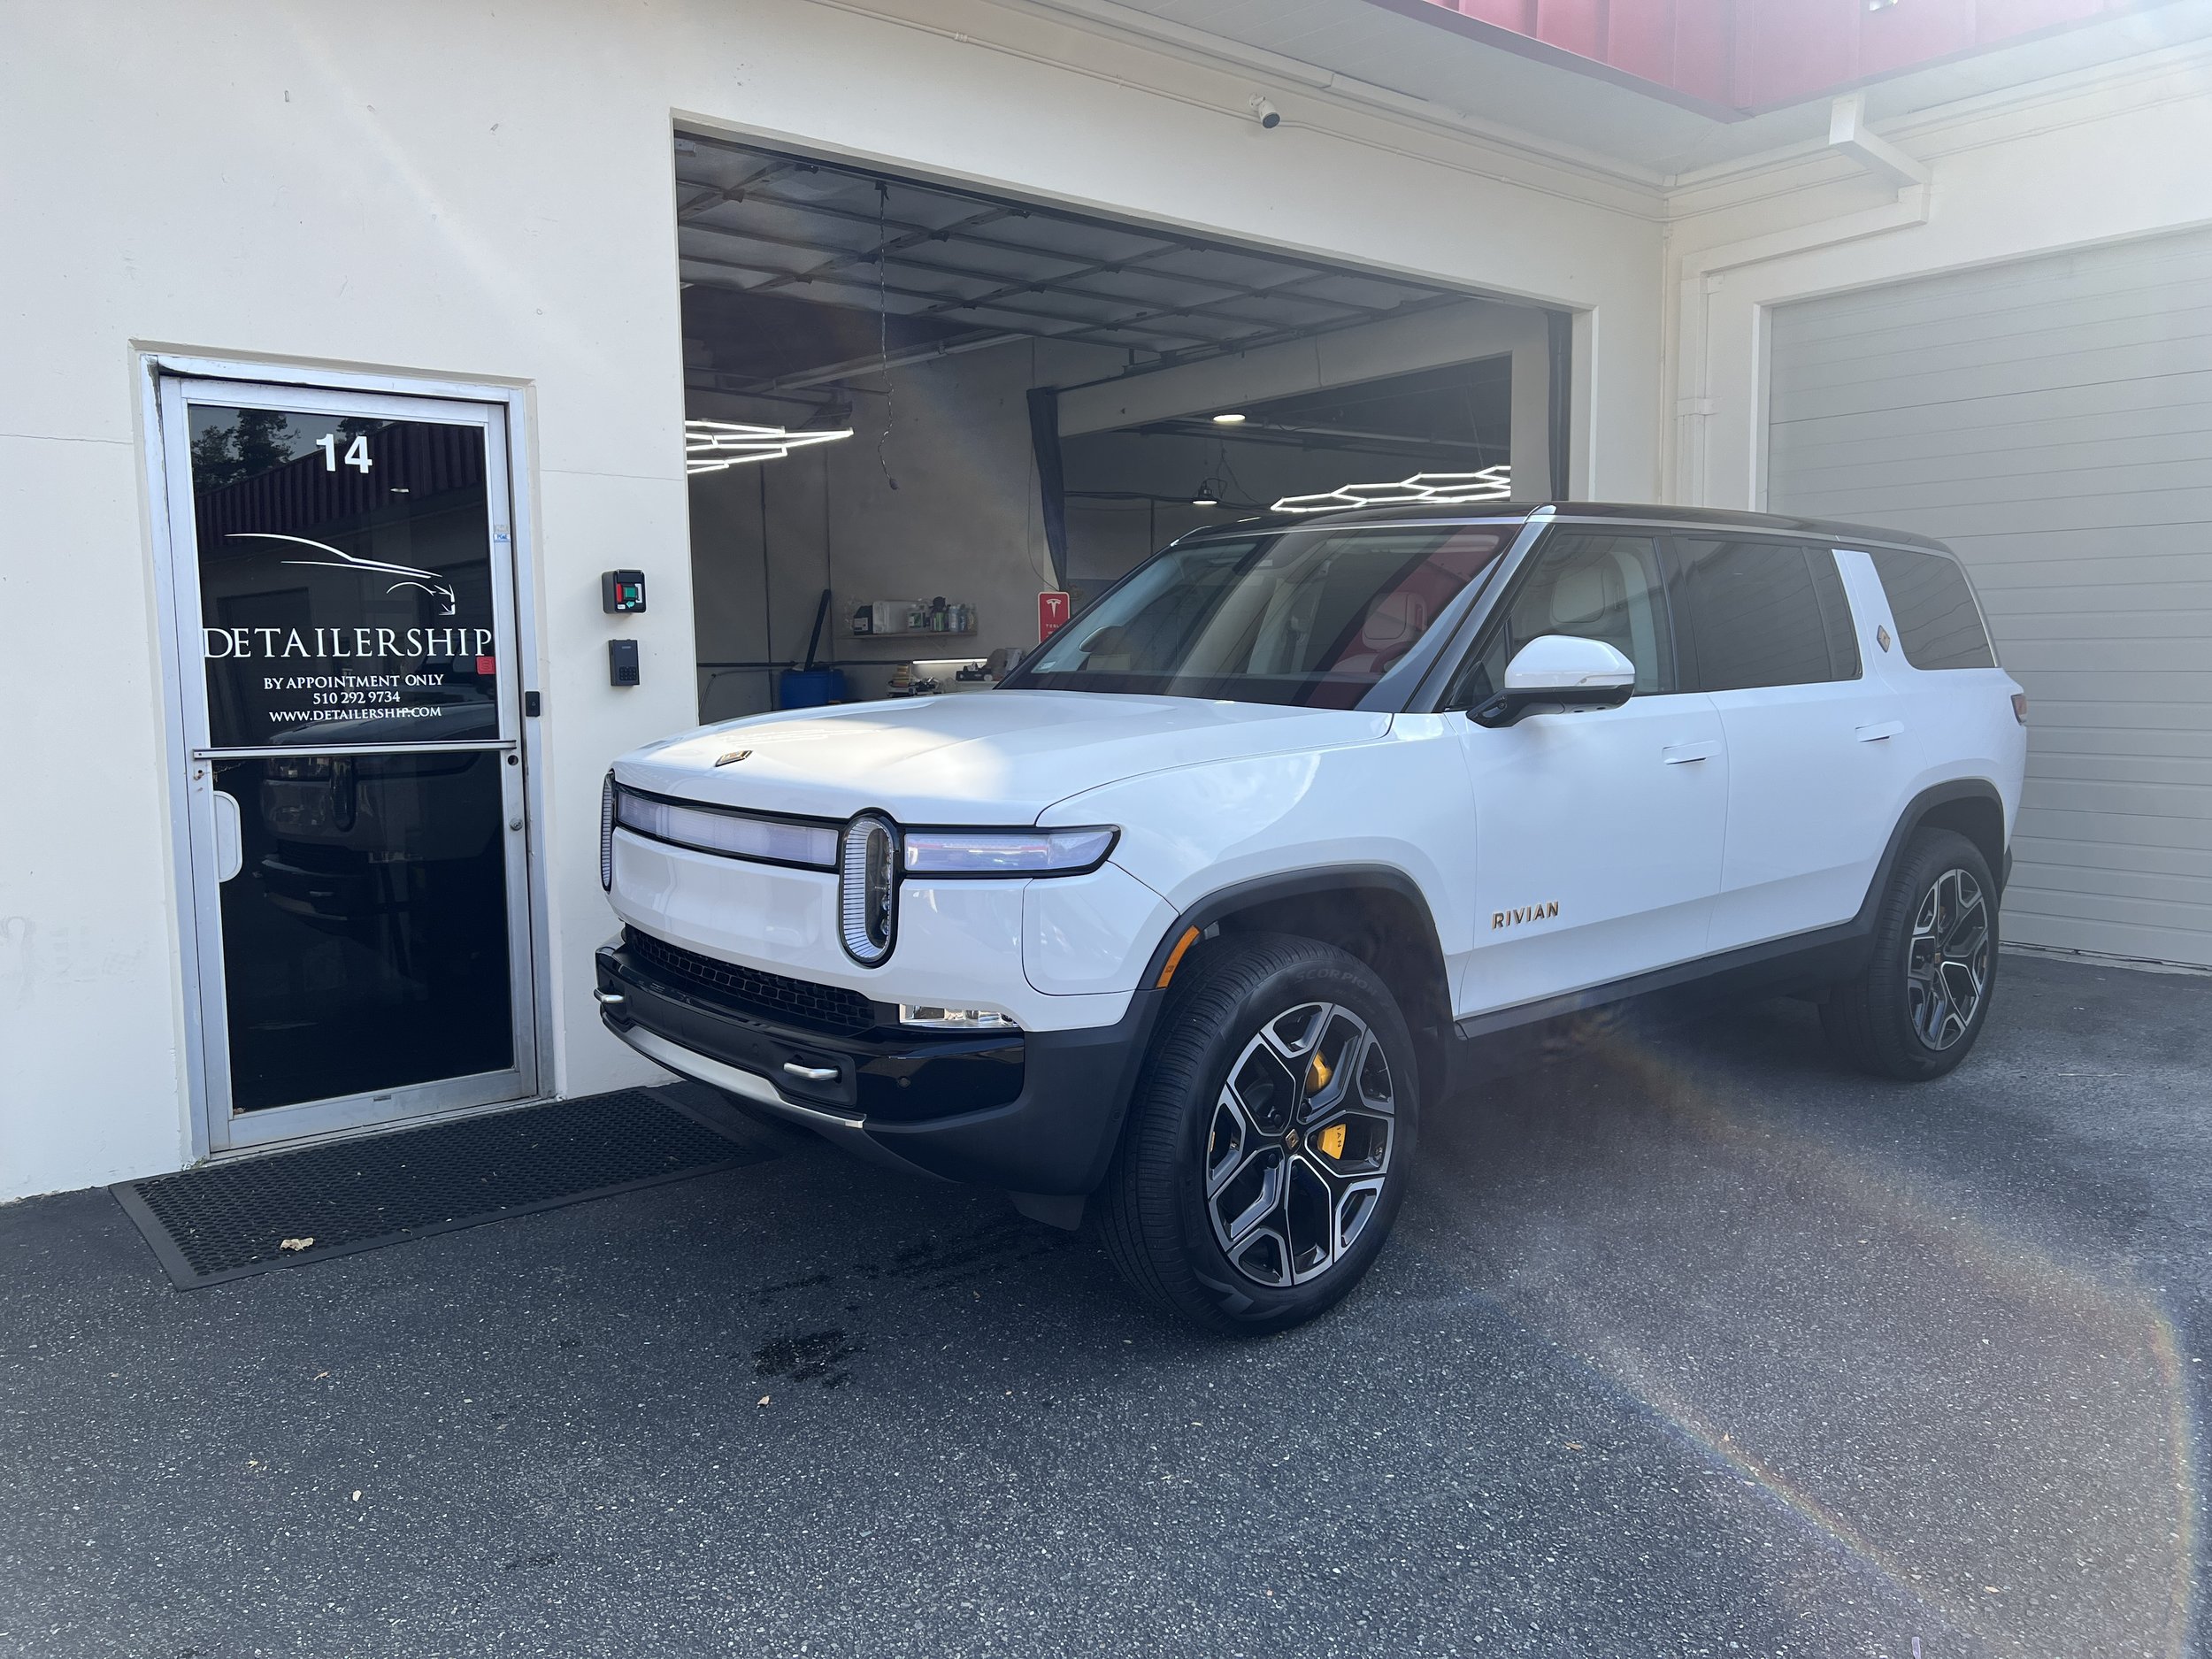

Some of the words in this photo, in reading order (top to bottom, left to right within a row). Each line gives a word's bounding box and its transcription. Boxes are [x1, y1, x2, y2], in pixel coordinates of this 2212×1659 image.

[316, 433, 373, 473] 14
[203, 627, 492, 658] DETAILERSHIP
[264, 677, 284, 690] BY
[286, 675, 400, 689] APPOINTMENT
[404, 673, 444, 687] ONLY
[312, 692, 338, 705] 510
[341, 692, 366, 704] 292
[368, 691, 401, 703] 9734
[269, 706, 442, 722] WWW.DETAILERSHIP.COM
[1491, 901, 1559, 930] RIVIAN
[1294, 968, 1378, 996] SCORPION
